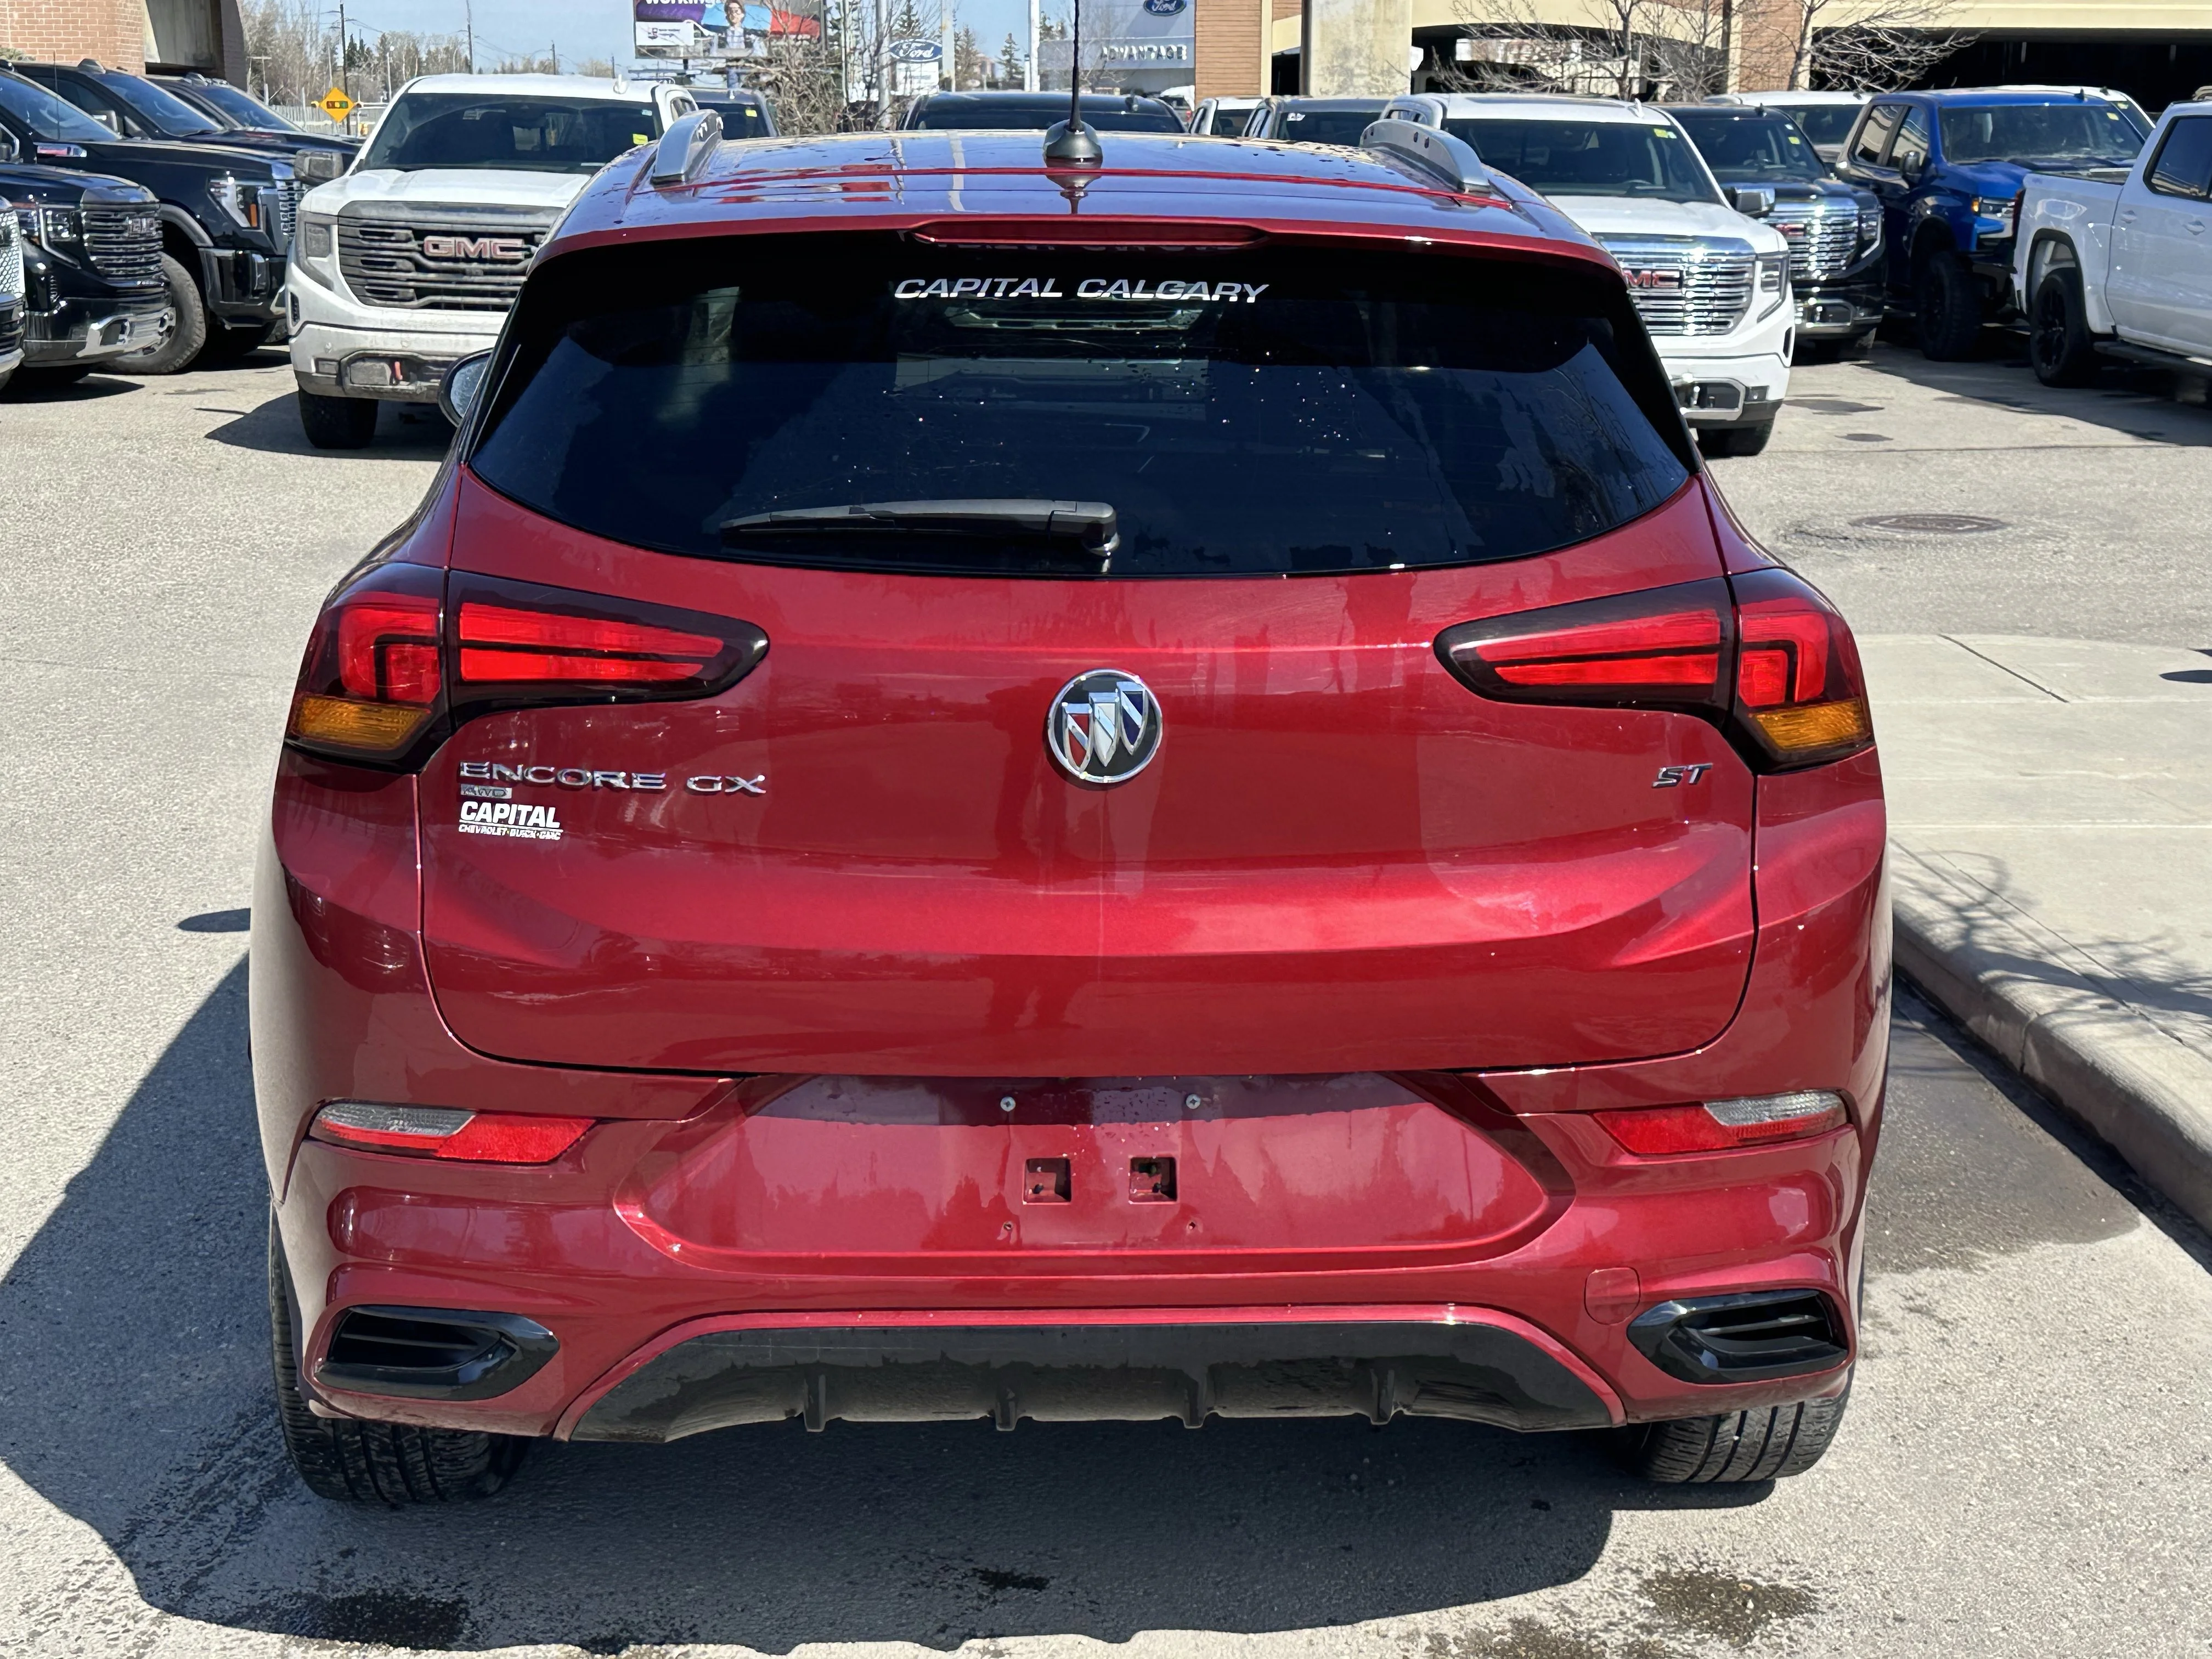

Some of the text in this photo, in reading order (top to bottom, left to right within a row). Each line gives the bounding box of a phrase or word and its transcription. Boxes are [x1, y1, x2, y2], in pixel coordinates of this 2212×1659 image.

[898, 42, 934, 58] Ford
[424, 235, 524, 259] GMC
[894, 278, 1269, 303] CAPITAL CALGARY
[1622, 269, 1680, 288] MC
[459, 761, 766, 794] ENCORE GX
[1651, 763, 1713, 788] ST
[460, 801, 561, 828] CAPITAL
